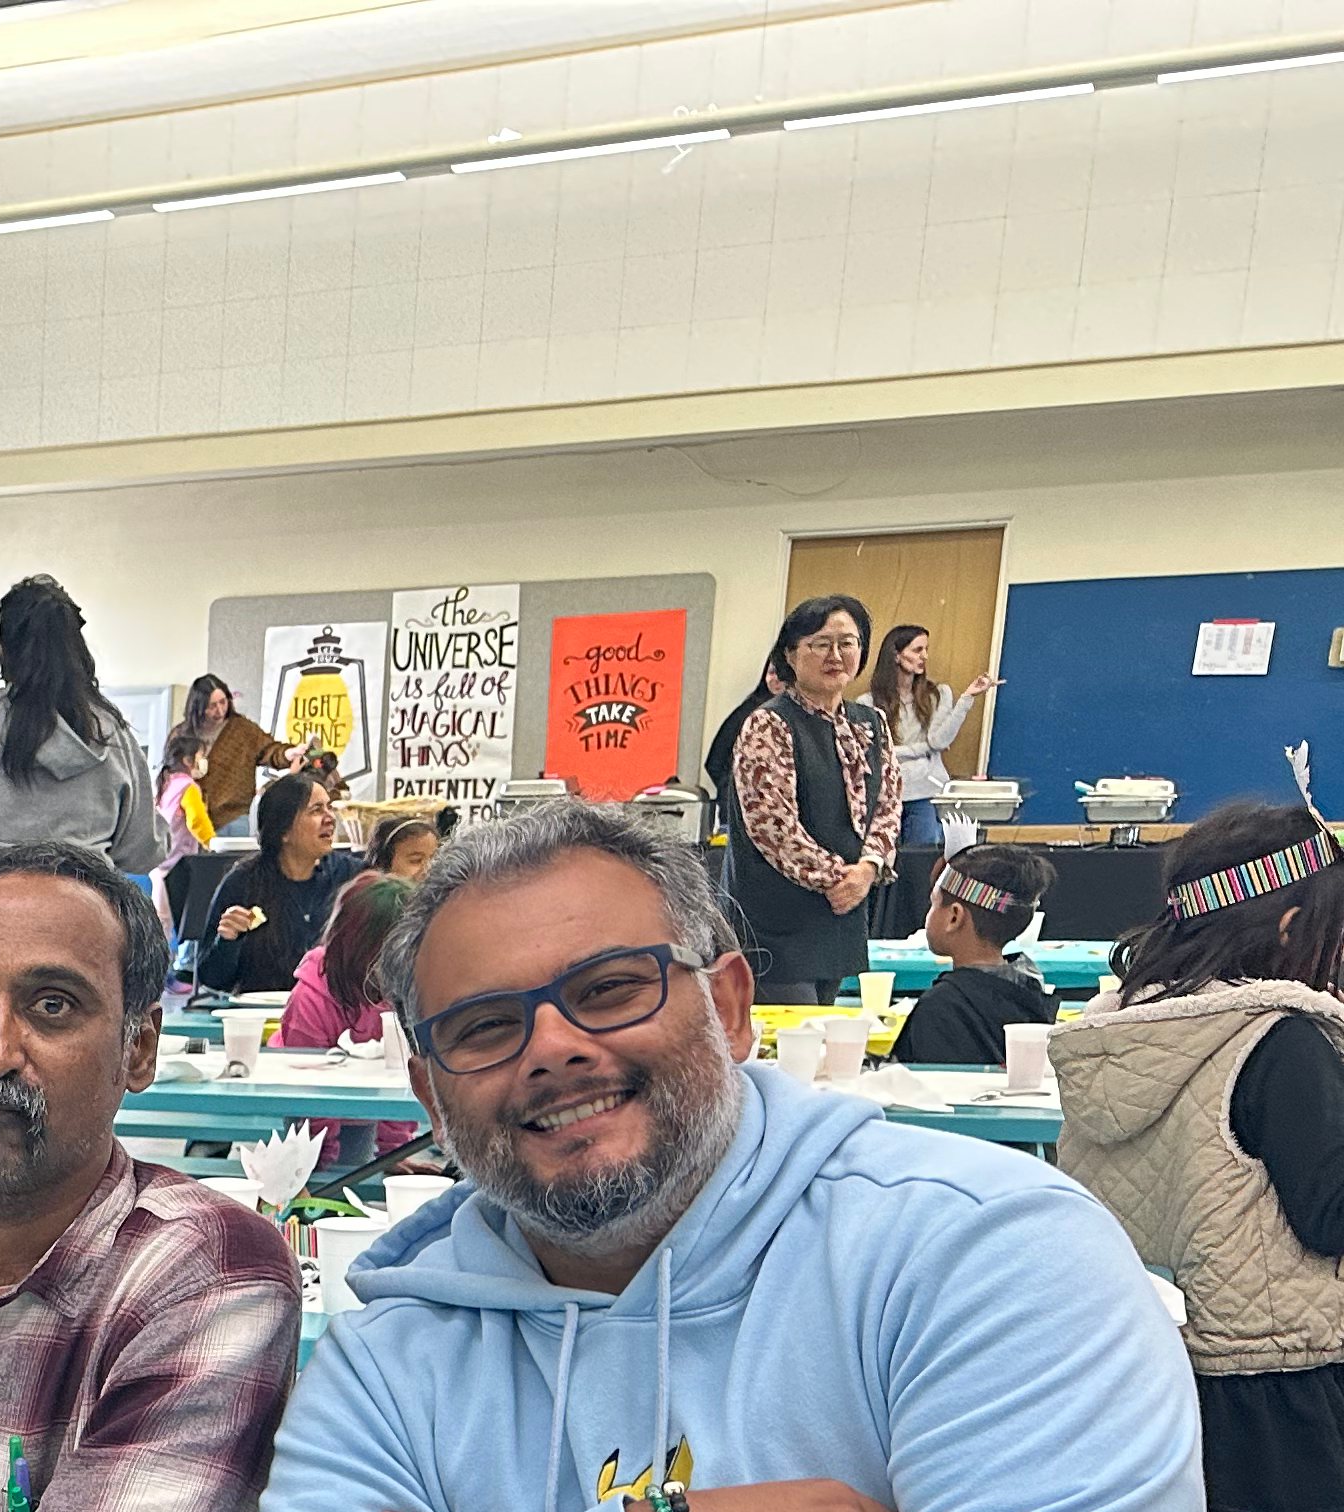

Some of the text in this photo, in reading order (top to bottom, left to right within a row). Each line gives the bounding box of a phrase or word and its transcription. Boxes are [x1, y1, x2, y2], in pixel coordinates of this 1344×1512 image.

[431, 586, 489, 626] the
[393, 621, 518, 671] UNIVERSE
[568, 632, 661, 674] good
[391, 670, 512, 711] is full of
[563, 672, 664, 705] THINGS
[293, 693, 347, 720] LIGHT
[391, 703, 507, 738] MAGICAL
[585, 703, 636, 724] TAKE
[392, 737, 470, 768] THINGS
[579, 729, 632, 752] TIME
[393, 778, 496, 800] PATIENTLY
[469, 804, 494, 825] FO
